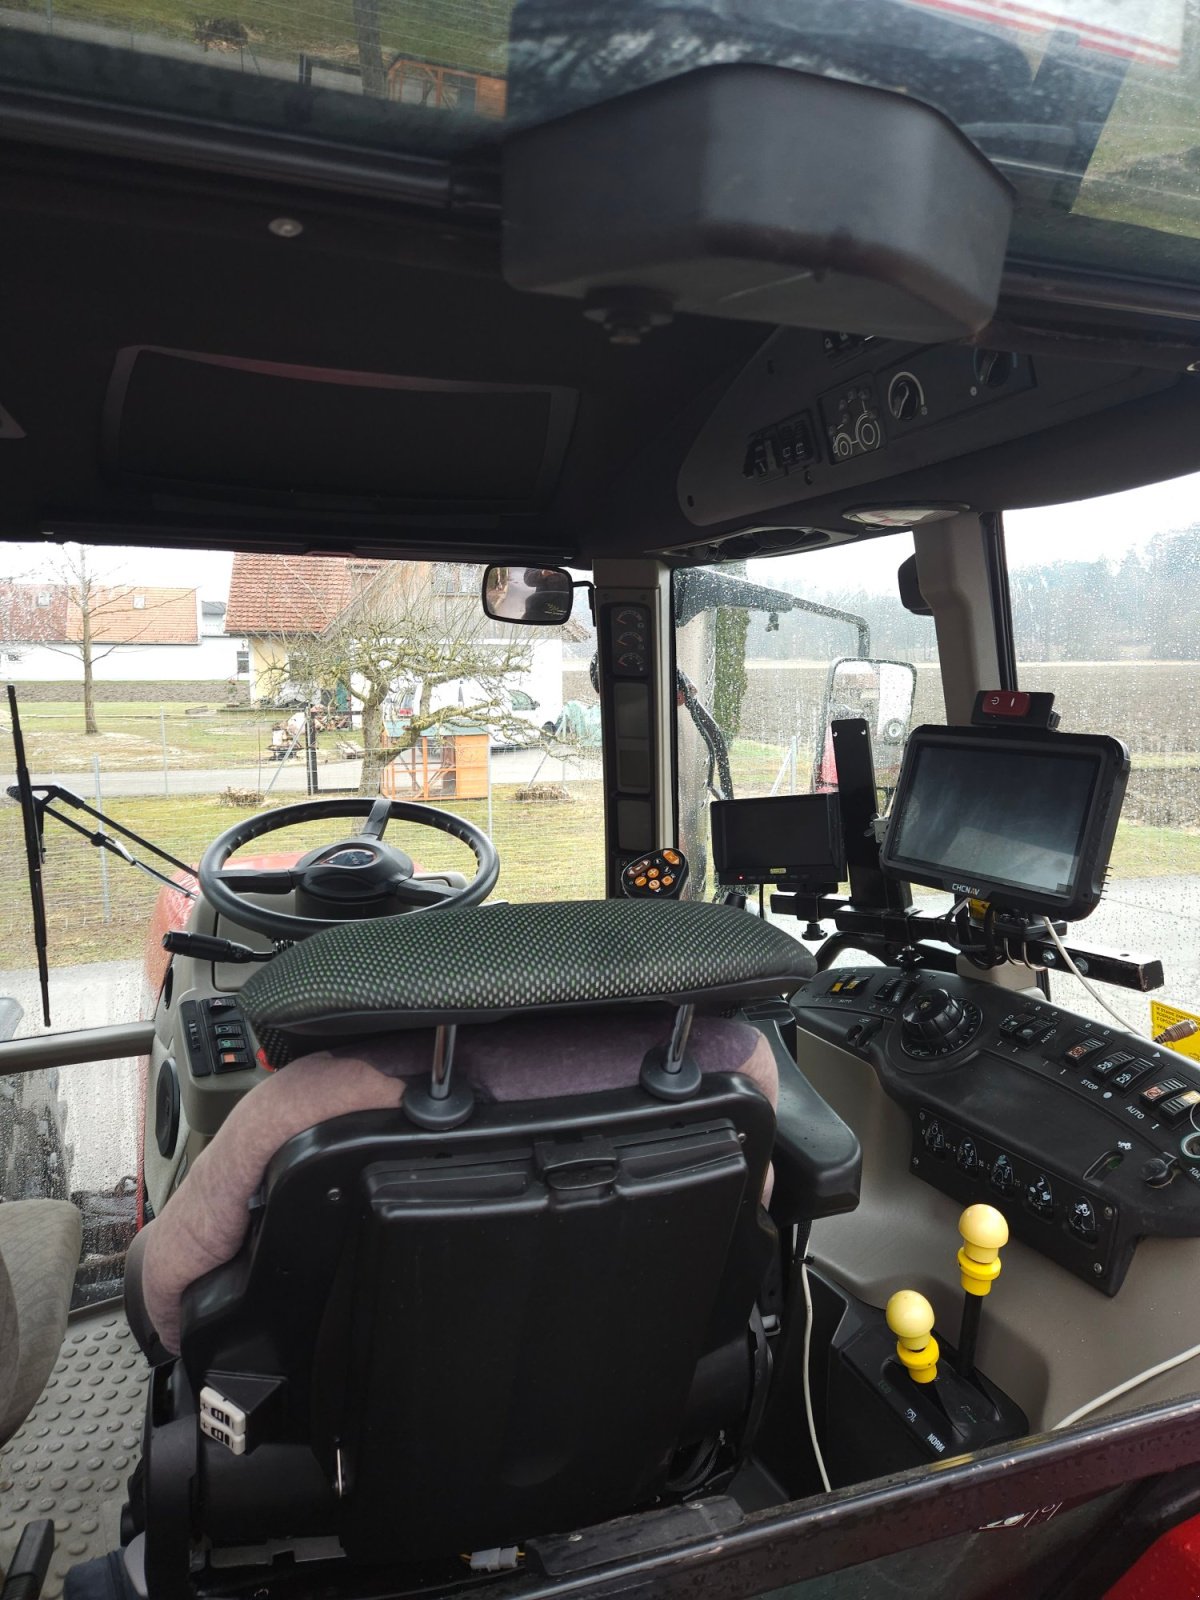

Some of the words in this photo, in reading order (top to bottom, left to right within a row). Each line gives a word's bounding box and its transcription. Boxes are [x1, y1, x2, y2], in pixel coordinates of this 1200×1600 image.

[952, 883, 980, 896] CHCNAV
[1041, 1029, 1056, 1043] AUTO
[1081, 1080, 1099, 1091] STOP
[1125, 1105, 1145, 1119] AUTO
[927, 1433, 946, 1453] NORM
